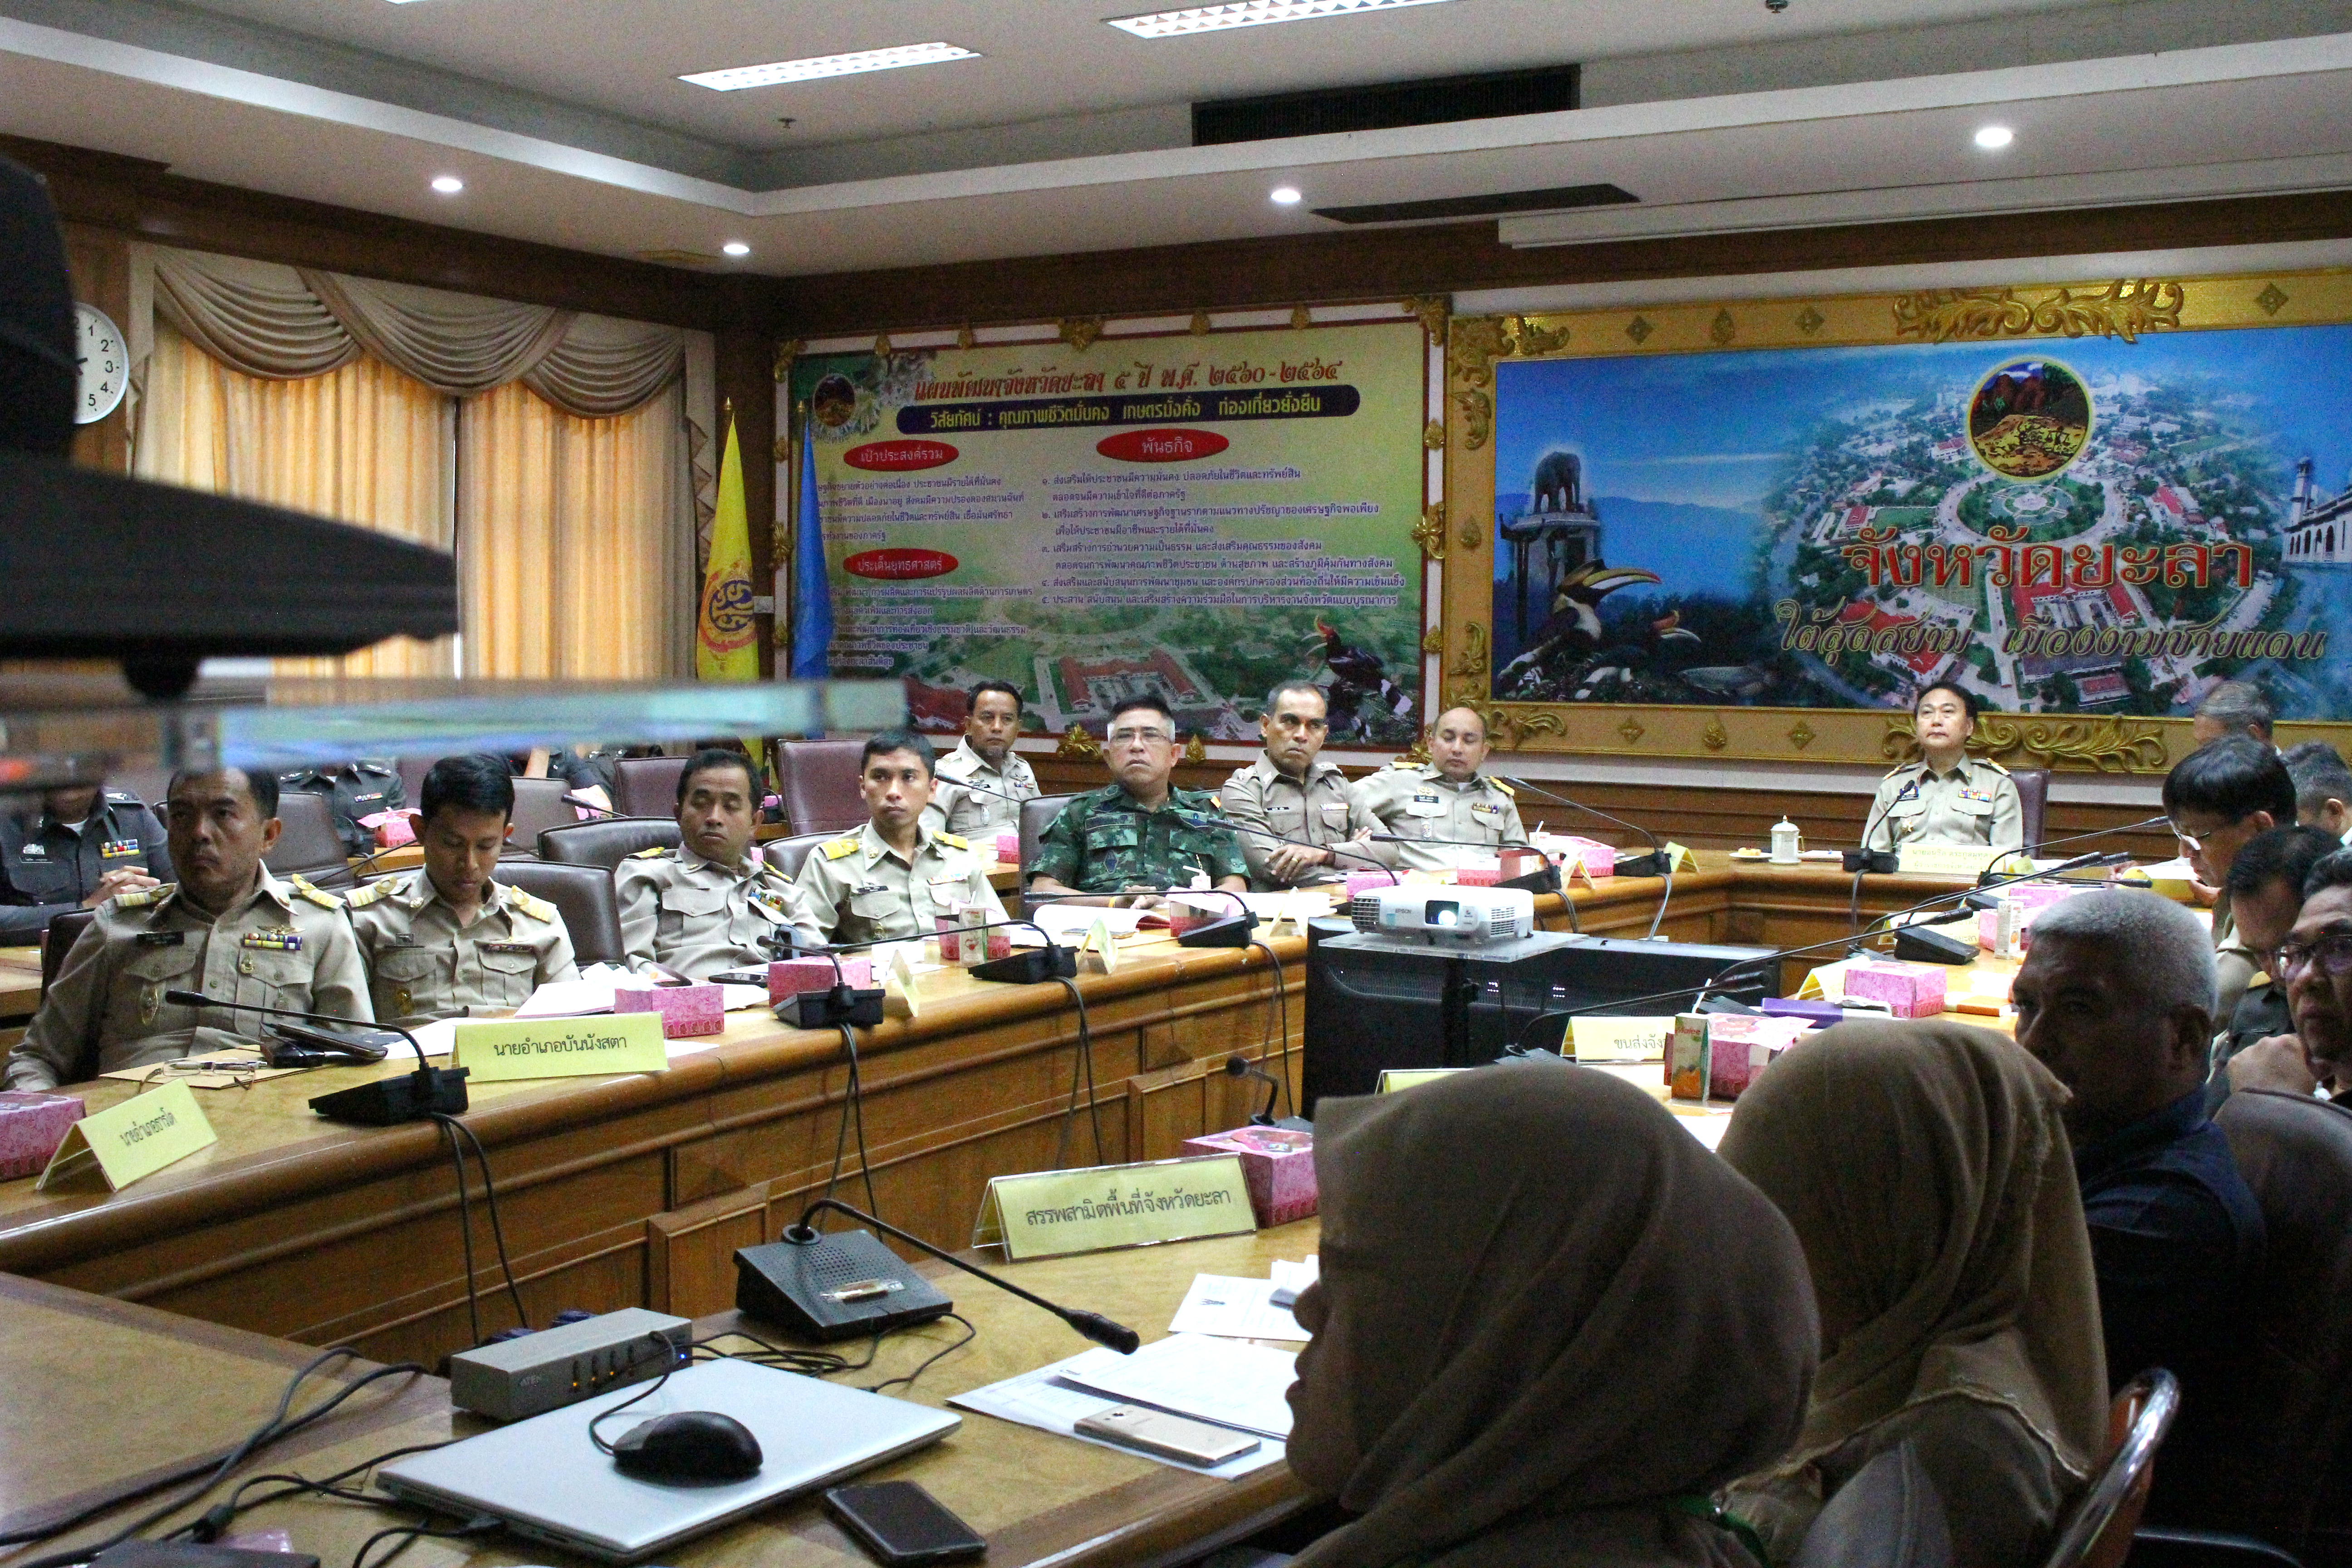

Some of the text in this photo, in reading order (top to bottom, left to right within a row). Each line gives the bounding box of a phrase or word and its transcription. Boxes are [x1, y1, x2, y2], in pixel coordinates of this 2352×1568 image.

[88, 325, 93, 336] 1
[101, 339, 109, 352] 2
[105, 360, 114, 373] 3
[100, 381, 109, 393] 4
[914, 366, 1106, 401] แผนพัฒนาจังหวัดยะลา
[1133, 361, 1154, 389] ปี
[88, 393, 96, 407] 5
[930, 409, 981, 428] วิสัยทัศน์
[999, 401, 1110, 429] คุณภาพชีวิตมั่นคง
[1123, 396, 1201, 420] เกษตรมั่งคั่ง
[1219, 391, 1321, 416] ท่องเที่ยวยั่งยืน
[1142, 436, 1193, 454] พันธกิจ
[861, 445, 943, 462] เป้าประสงค์รวม
[1054, 469, 1180, 485] ส่งเสริมให้ประชาชนมีความมั่นคง
[1183, 466, 1301, 481] ปลอดภัยในชีวิตและทรัพย์สิน
[818, 477, 910, 494] ษฐกิจขยายตัวอย่างต่อเนื่อง
[1053, 488, 1186, 501] ตลอดจนมีความเข้าใจที่ดีต่อภาครัฐ
[820, 508, 960, 523] ชาชนมีความปลอดภัยในชีวิตและทรัพย์สิน
[1055, 520, 1214, 535] เพื่อให้ประชาชนมีอาชีพและรายได้ที่มั่นคง
[822, 530, 886, 542] รทำงานของภาครัฐ
[1054, 539, 1192, 553] เสริมสร้างการอำนวยความเป็นธรรม
[1196, 539, 1322, 553] และส่งเสริมคุณธรรมของสังคม
[1841, 525, 2254, 588] จังหวัดยะลา
[858, 555, 944, 575] ประเด็นยุทธศาสตร์
[1220, 558, 1269, 571] ด้านสุขภาพ
[1273, 557, 1392, 572] และสร้างภูมิคุ้มกันทางสังคม
[1054, 575, 1198, 589] ส่งเสริมและสนับสนุนการพัฒนาชุมชน
[1054, 595, 1084, 604] ประสาน
[1774, 595, 2327, 666] ใต้สุดสยาม เมืองงามชายแดน
[494, 1032, 627, 1056] นายอำเภอบันนังสตา
[1614, 1034, 1666, 1049] ขนส่งจัง
[1026, 1187, 1232, 1226] สรรพสามิตพื้นที่จังหวัดยะลา
